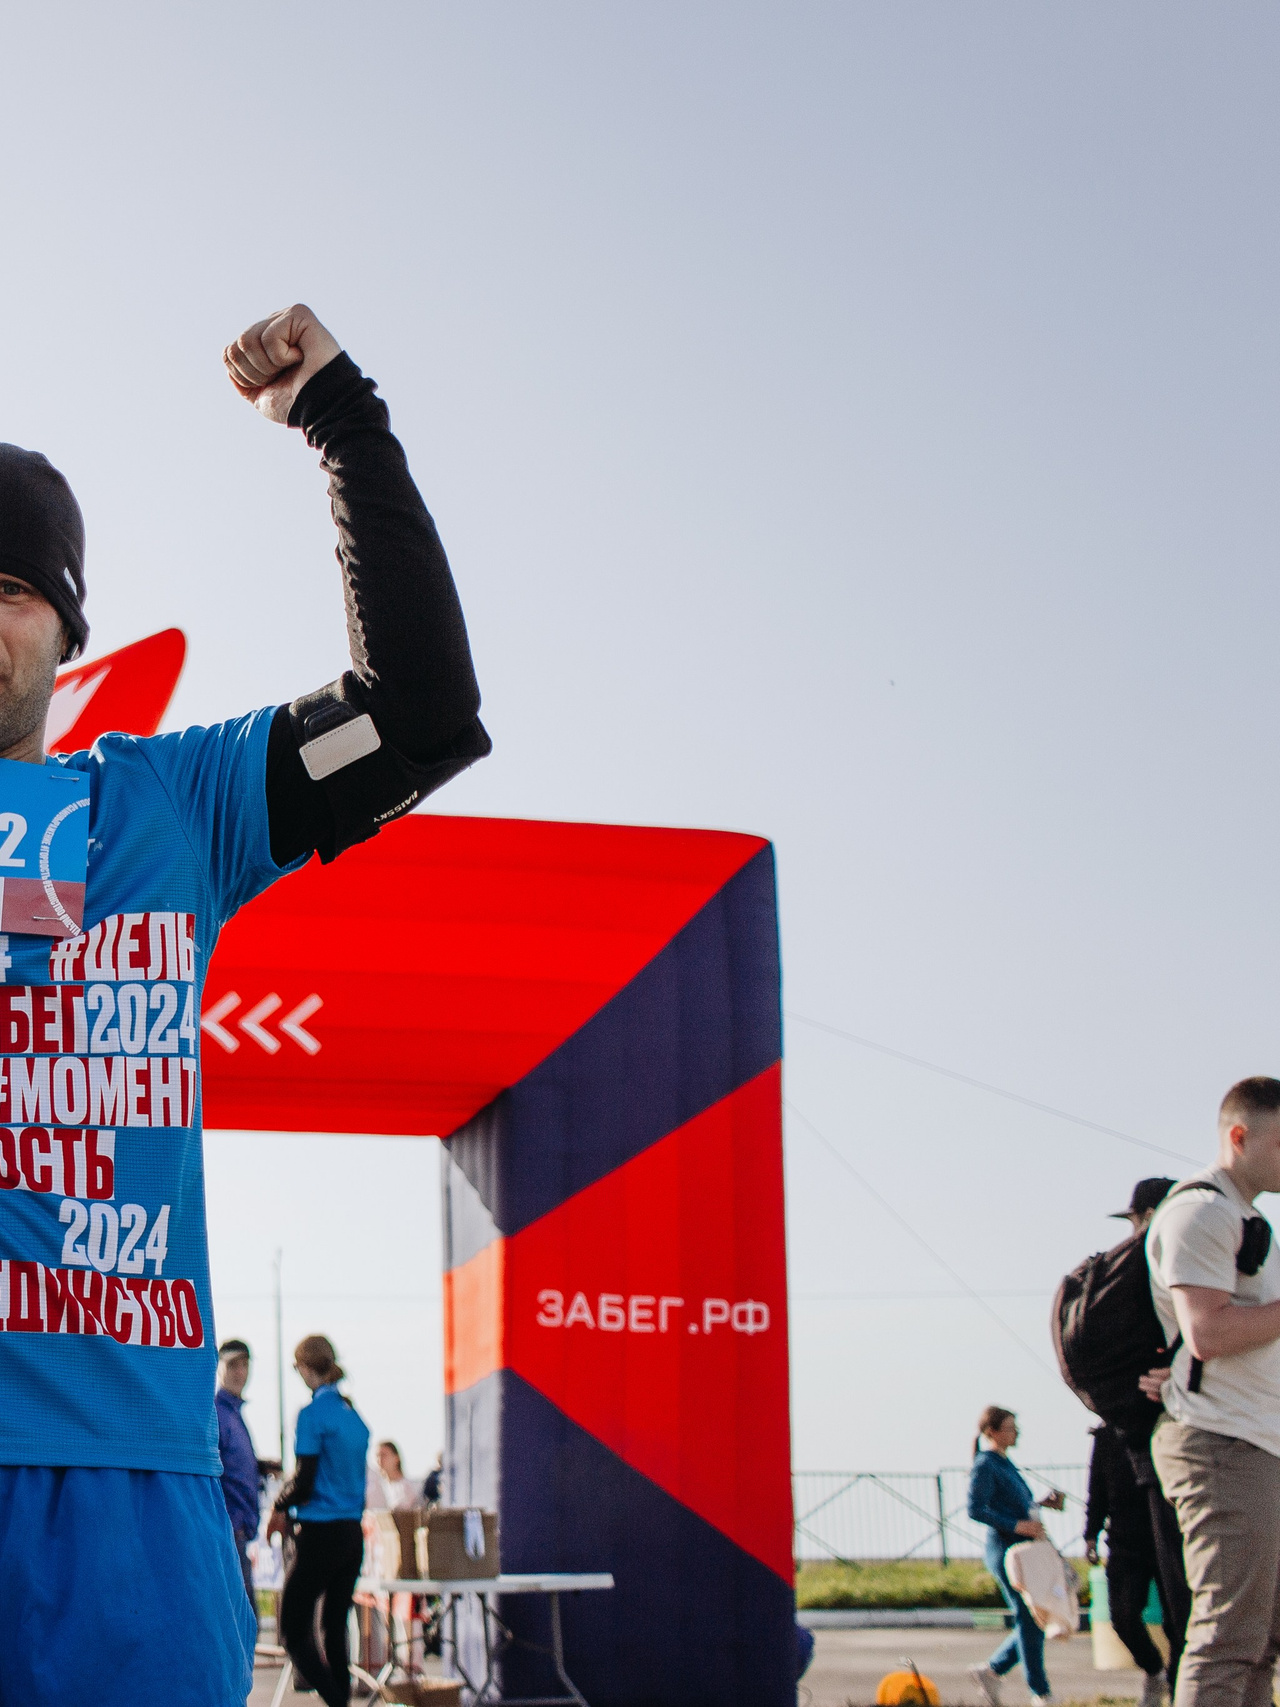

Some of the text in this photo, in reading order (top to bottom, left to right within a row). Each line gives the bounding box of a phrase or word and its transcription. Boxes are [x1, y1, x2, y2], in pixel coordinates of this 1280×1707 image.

[49, 912, 195, 981] #ЦЕЛЬ
[58, 1198, 171, 1275] 2024
[535, 1288, 770, 1336] ЗАБЕГ.РФ
